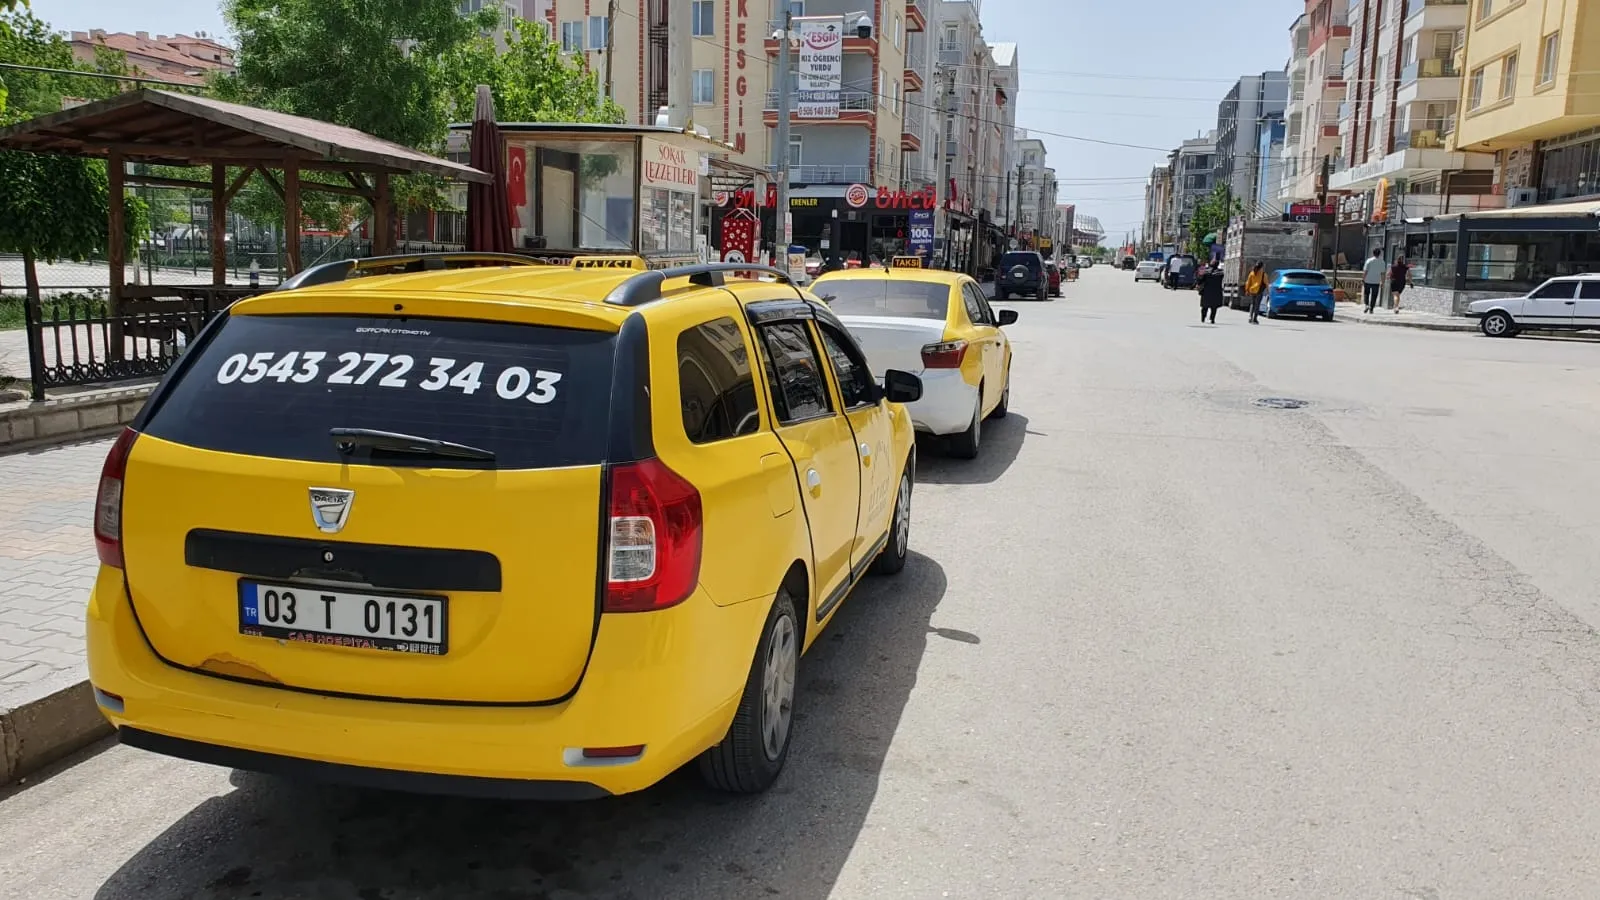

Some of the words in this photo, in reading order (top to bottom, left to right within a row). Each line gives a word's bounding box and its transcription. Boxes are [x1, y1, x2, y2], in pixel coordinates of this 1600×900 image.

[810, 63, 831, 71] YURDU
[658, 144, 687, 166] SOKAK
[791, 198, 818, 206] ERENLER
[910, 228, 932, 238] 100.
[217, 351, 327, 385] 0543
[328, 352, 414, 388] 272
[419, 358, 485, 394] 34
[496, 366, 562, 404] 03
[314, 495, 343, 503] DACIA
[244, 606, 257, 617] TR
[264, 590, 297, 625] 03
[320, 594, 337, 630] T
[364, 599, 434, 639] 0131
